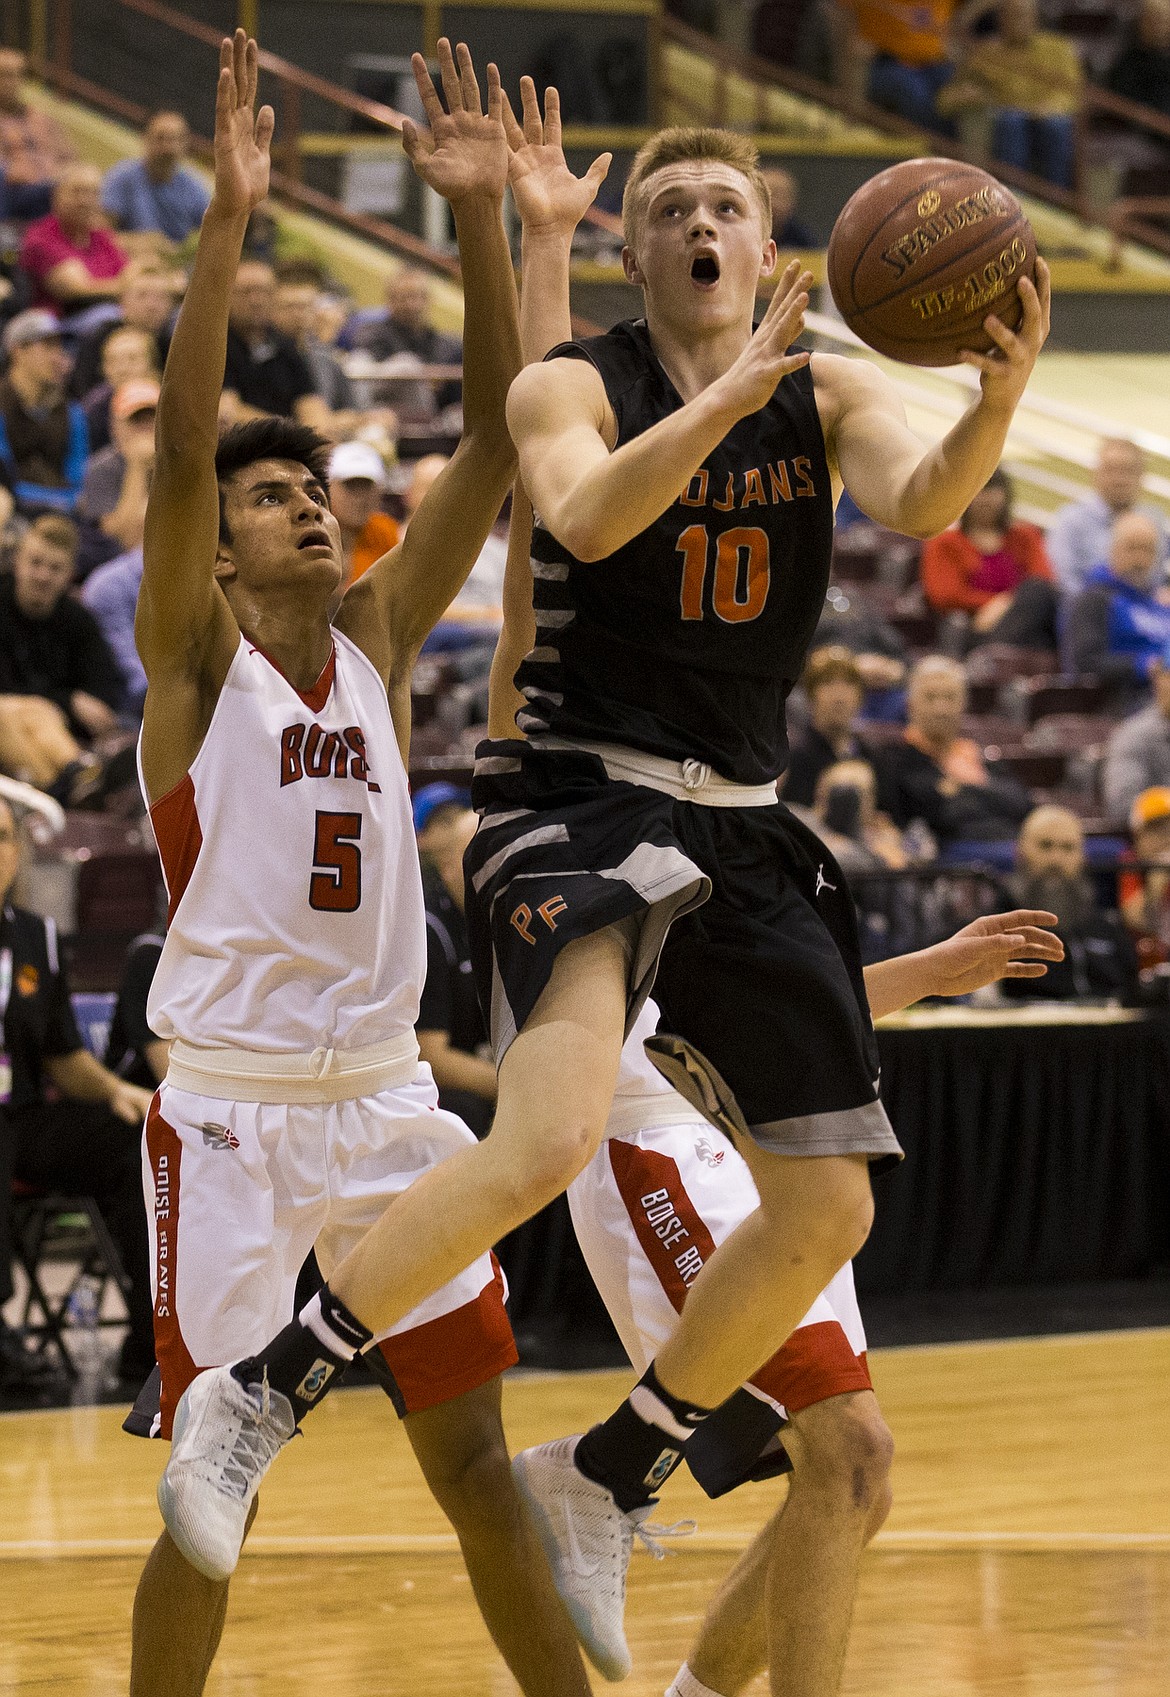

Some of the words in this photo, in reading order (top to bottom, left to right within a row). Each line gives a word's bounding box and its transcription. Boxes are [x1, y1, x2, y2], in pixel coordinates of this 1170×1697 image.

[679, 455, 817, 512] OJANS
[675, 523, 771, 625] 10
[280, 722, 382, 794] BOIS
[308, 809, 362, 913] 5
[640, 1187, 690, 1251] BOISE
[673, 1244, 705, 1289] BR
